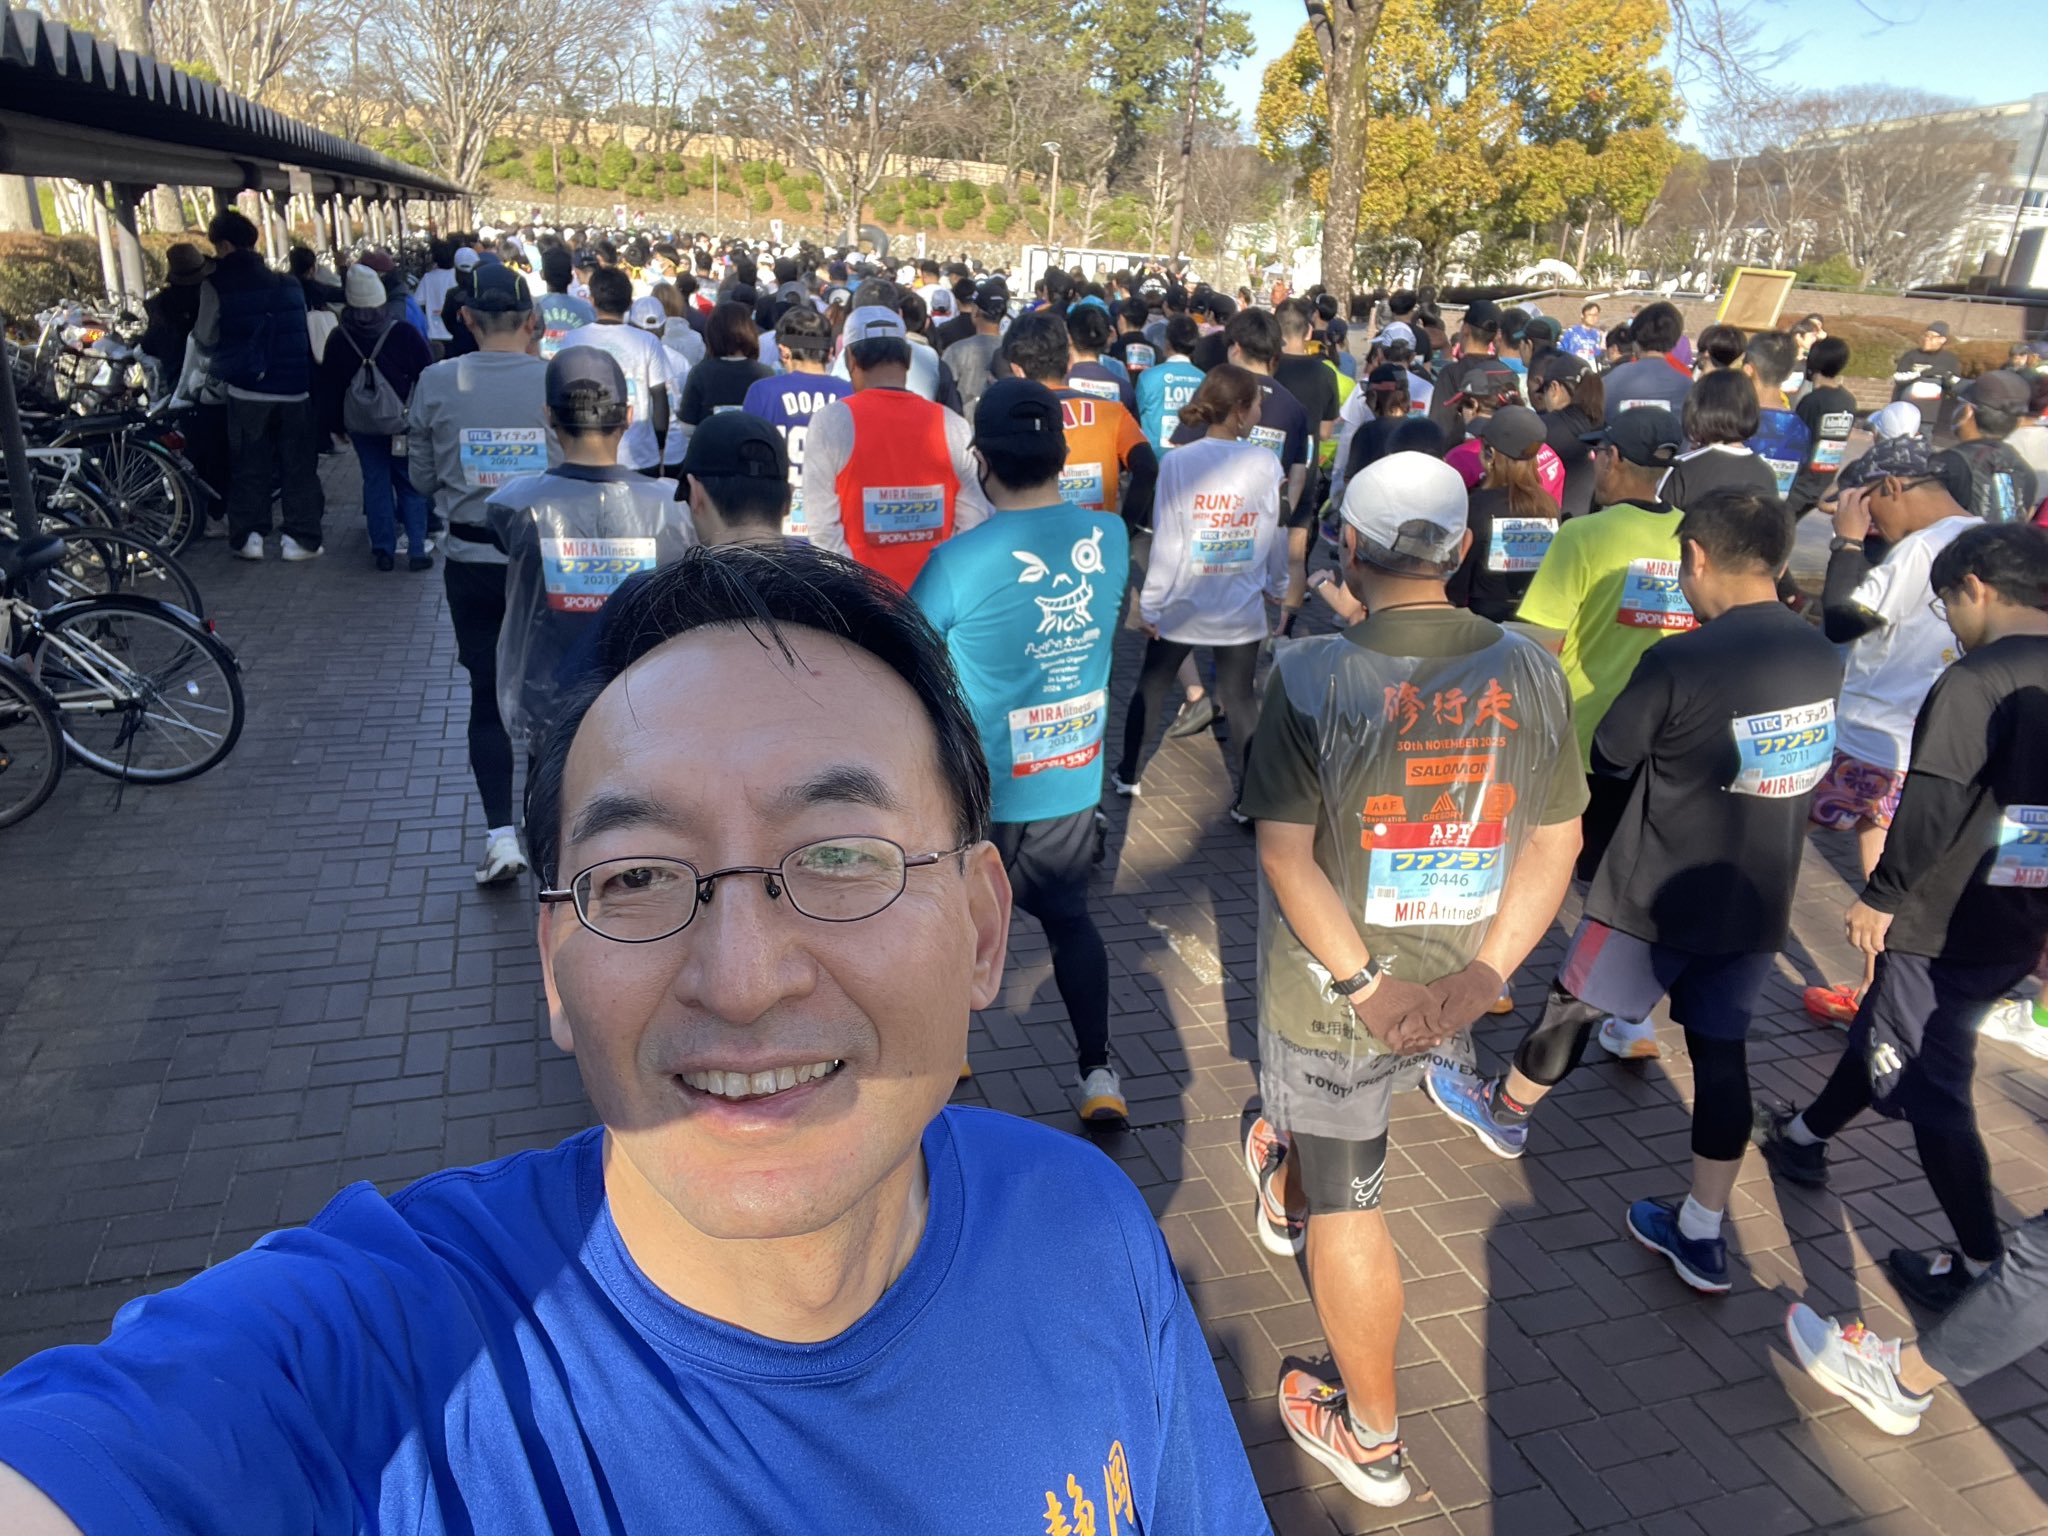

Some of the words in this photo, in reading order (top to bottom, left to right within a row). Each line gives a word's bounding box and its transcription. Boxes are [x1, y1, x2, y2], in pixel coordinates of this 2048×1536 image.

[782, 391, 836, 416] DOA
[472, 444, 536, 456] ファンラン
[876, 501, 936, 516] ファンラン
[1193, 493, 1232, 511] RUN
[1209, 511, 1260, 529] SPLAT
[560, 559, 641, 574] ファンラン
[583, 575, 620, 585] 20218
[1383, 677, 1520, 736] 修行走
[1026, 713, 1096, 741] ファンラン
[1749, 716, 1780, 733] ITEC
[1048, 732, 1079, 749] 20336
[1425, 737, 1479, 751] NOVEMBER
[1757, 727, 1826, 755] ファンラン
[1780, 749, 1810, 766] 20711
[1410, 762, 1490, 778] SALOMON
[1422, 812, 1464, 822] GREGORY
[1429, 823, 1471, 840] API
[1395, 851, 1499, 871] ファンラン
[1420, 872, 1470, 887] 20446
